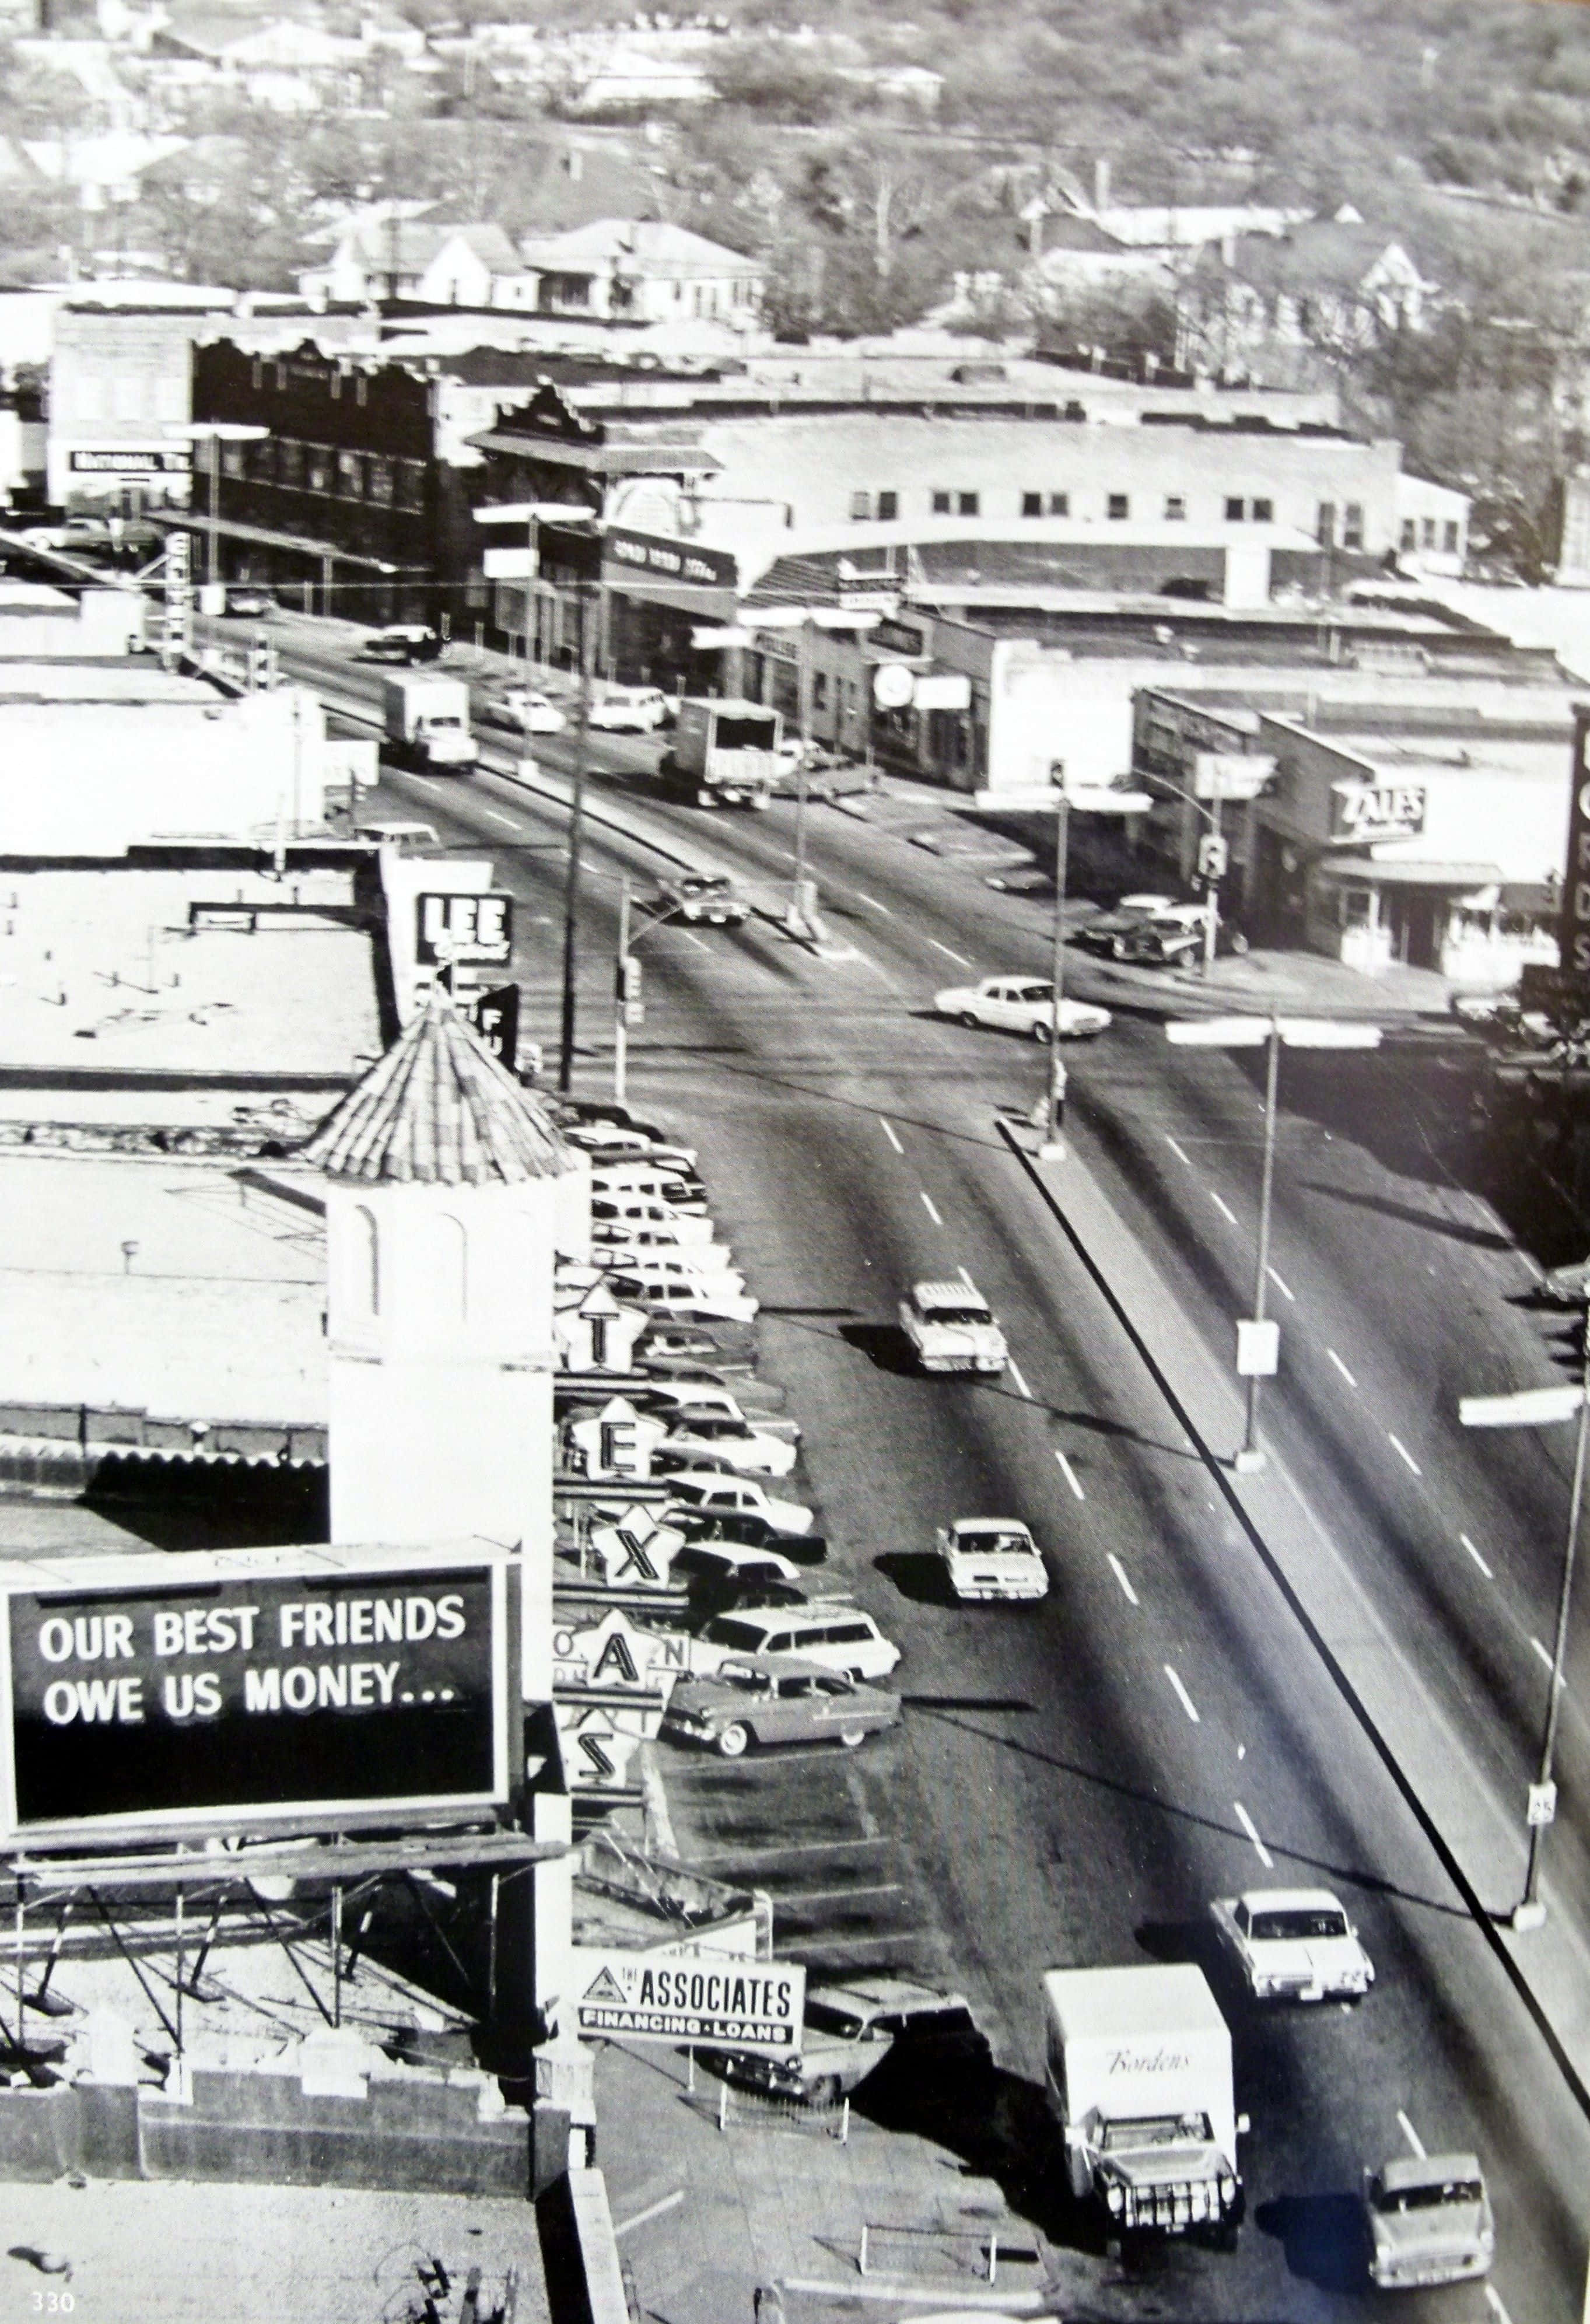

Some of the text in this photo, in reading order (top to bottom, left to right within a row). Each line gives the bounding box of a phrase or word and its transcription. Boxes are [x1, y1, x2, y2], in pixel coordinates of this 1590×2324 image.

[425, 897, 506, 944] LEE
[39, 1595, 466, 1662] OUR BEST FRIENDS
[44, 1661, 455, 1725] OWE US MONEY...
[640, 1969, 791, 2018] ASSOCIATES
[583, 2008, 786, 2042] FINANCING LOANS
